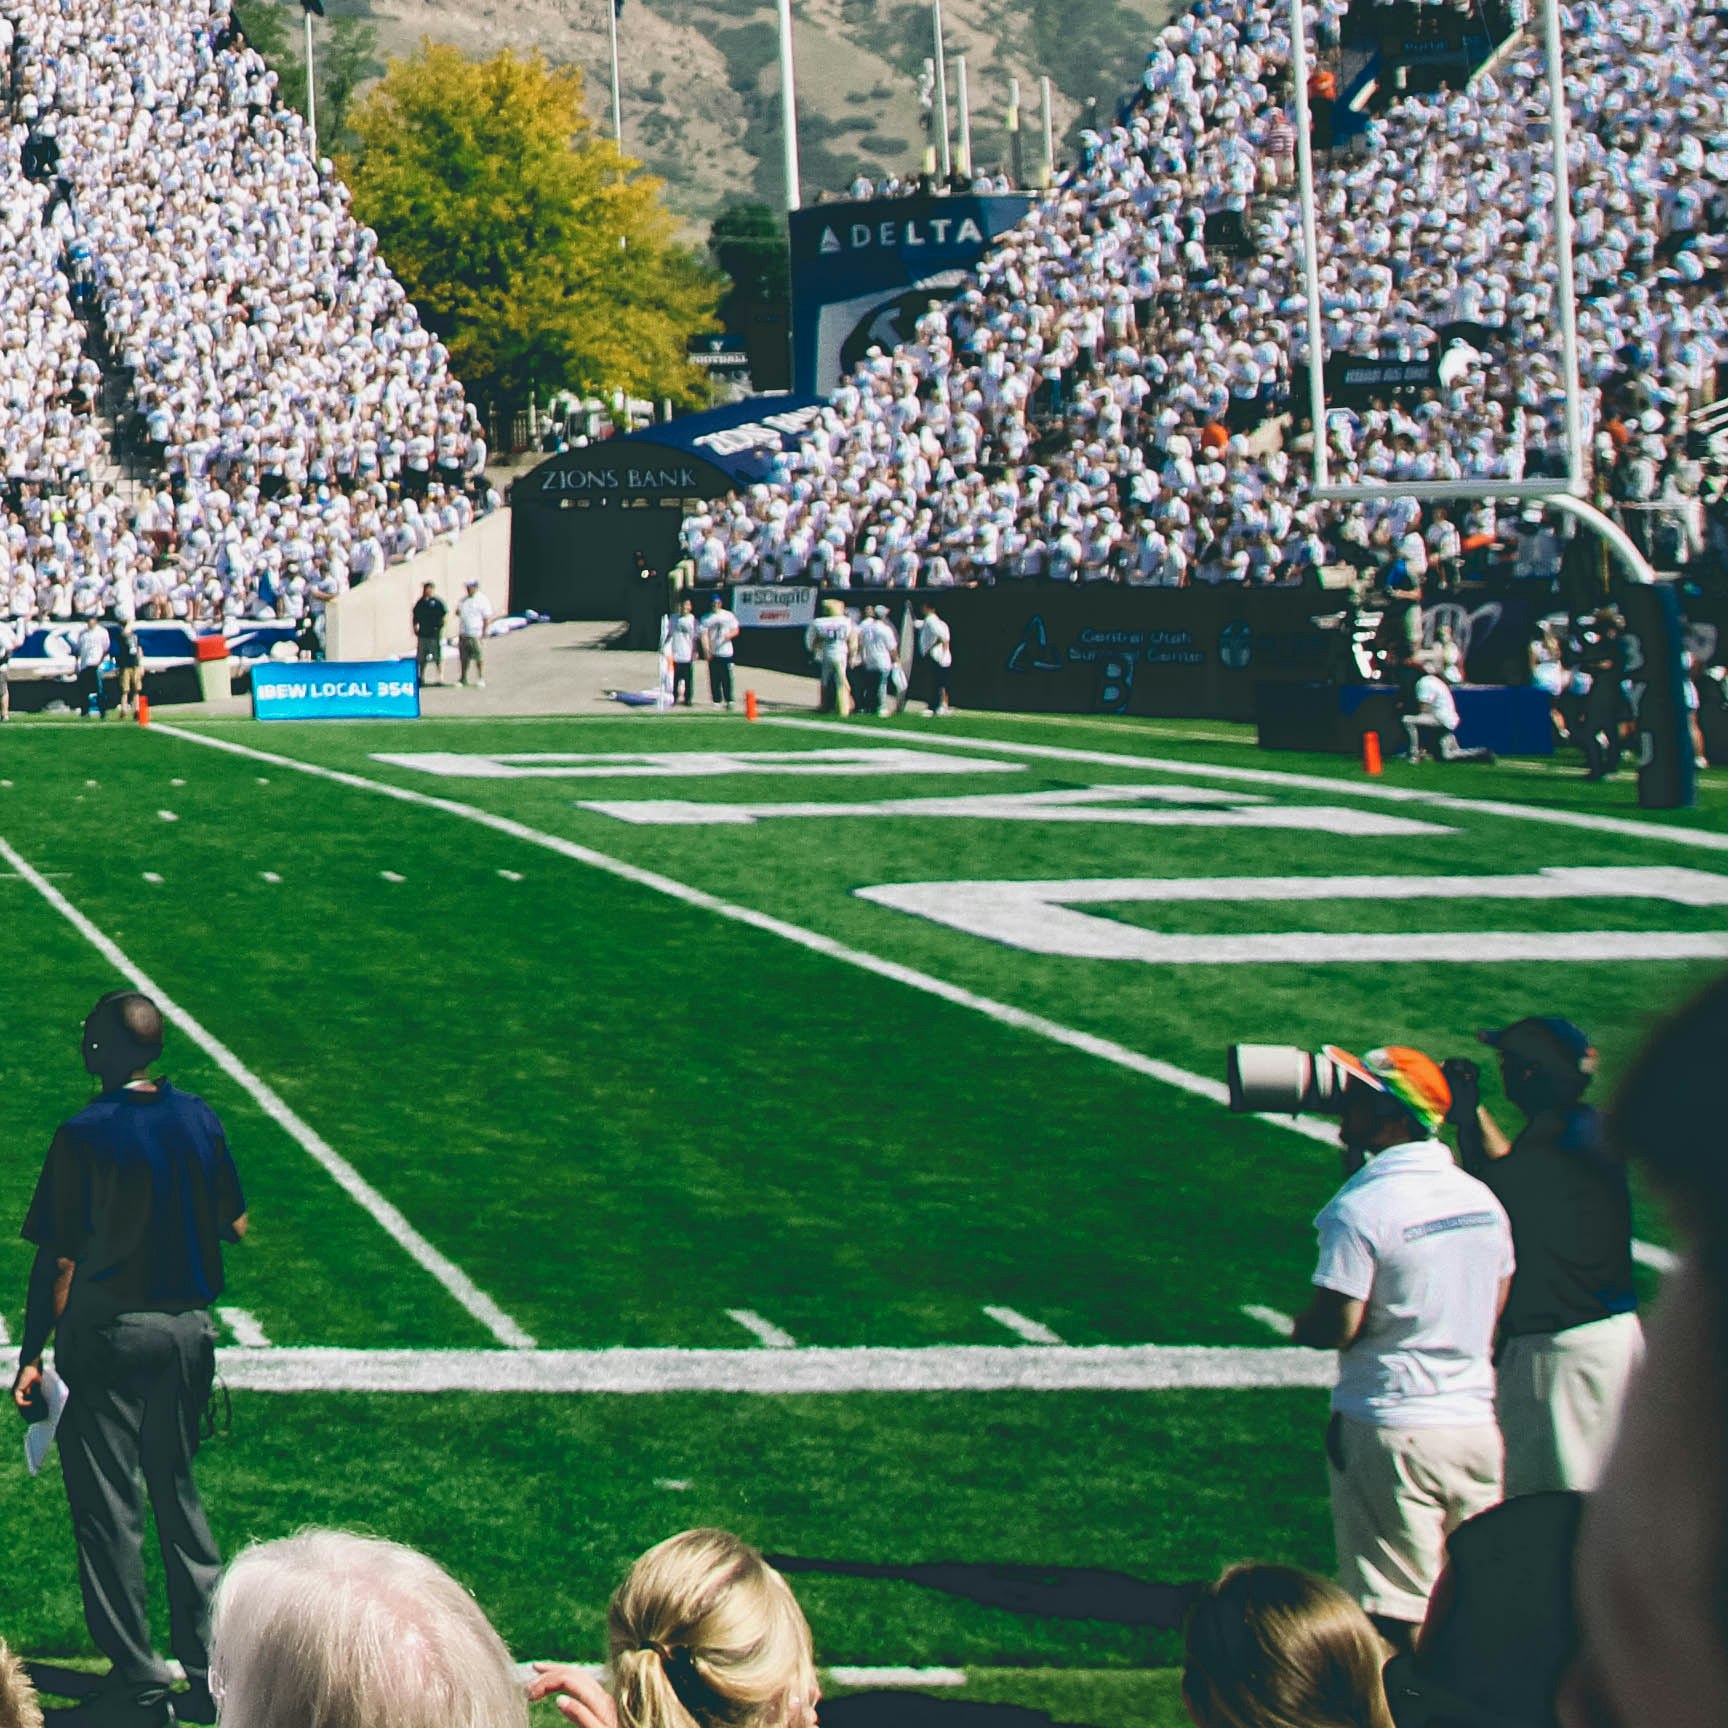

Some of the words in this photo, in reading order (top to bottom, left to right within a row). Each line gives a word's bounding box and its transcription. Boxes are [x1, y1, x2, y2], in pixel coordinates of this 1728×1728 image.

[851, 217, 984, 249] DELTA
[542, 469, 619, 490] ZIONS
[628, 467, 697, 489] BANK
[1082, 627, 1144, 645] Central
[1150, 629, 1193, 645] Utah
[257, 683, 307, 700] IBEW
[311, 682, 373, 698] LOCAL
[378, 681, 414, 697] 354
